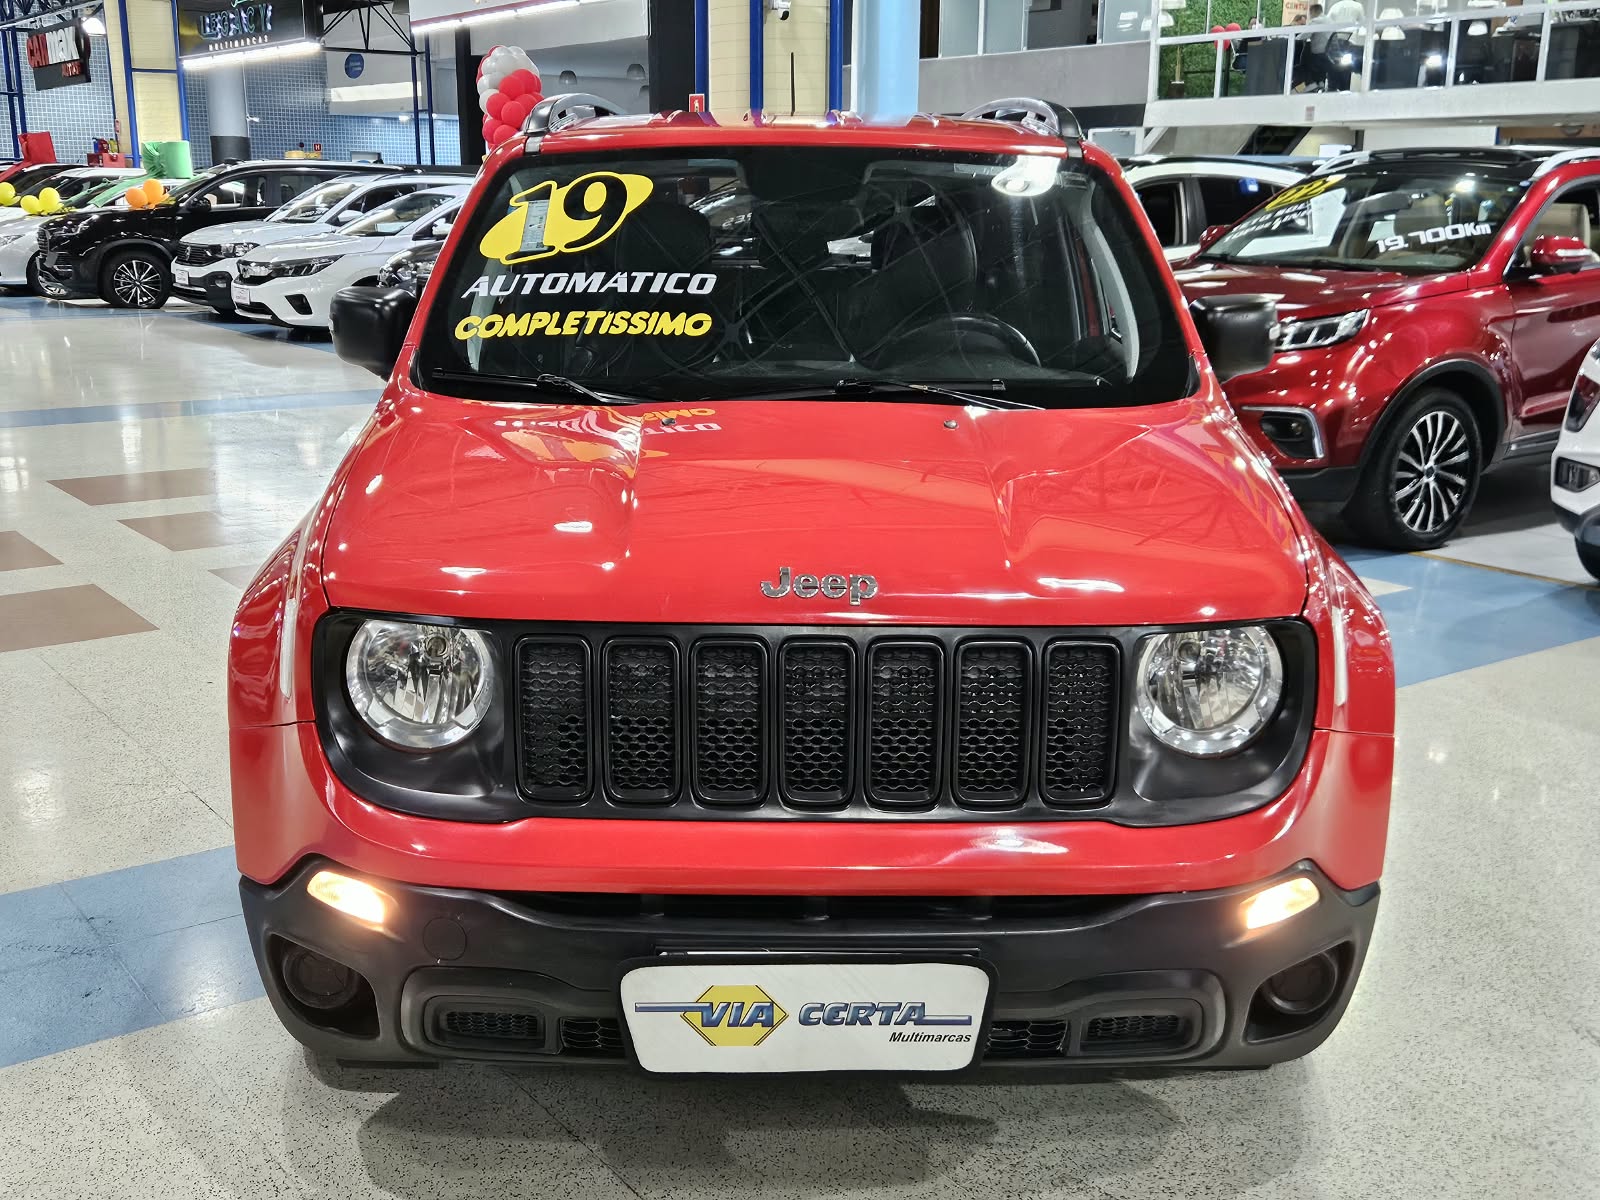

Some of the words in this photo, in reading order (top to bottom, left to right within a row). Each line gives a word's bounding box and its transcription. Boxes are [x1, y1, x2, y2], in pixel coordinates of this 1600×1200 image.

[199, 3, 273, 40] LEGACY
[208, 34, 269, 51] MULTIMARCAS
[501, 172, 629, 264] 19
[760, 566, 878, 606] Jeep
[700, 1001, 775, 1028] VIA
[799, 1001, 926, 1026] CERTA
[888, 1031, 972, 1043] Multimarcas
